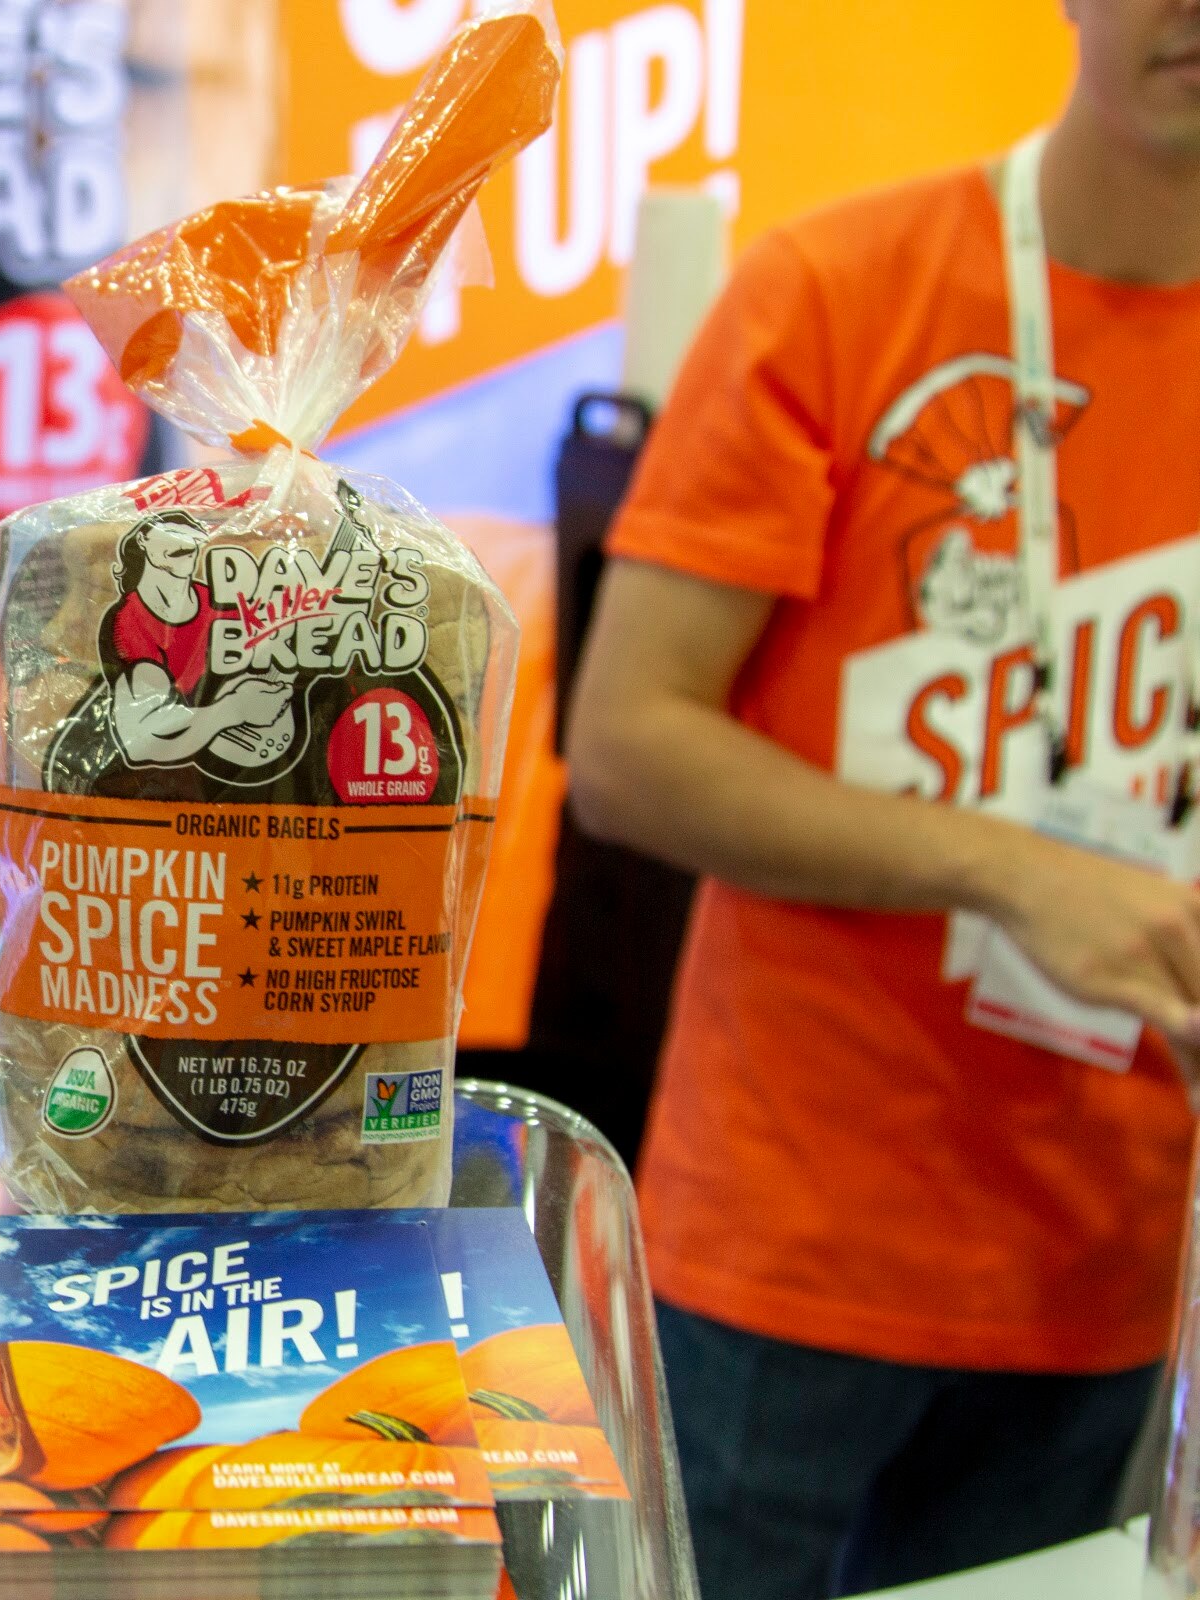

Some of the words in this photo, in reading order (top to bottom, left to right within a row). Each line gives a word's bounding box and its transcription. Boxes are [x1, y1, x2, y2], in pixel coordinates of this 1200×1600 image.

[513, 0, 743, 297] UP!
[207, 546, 431, 607] DAVE'S
[211, 611, 428, 675] BREAD
[347, 781, 383, 797] WHOLE
[386, 781, 426, 797] GRAINS
[175, 813, 260, 838] ORGANIC
[267, 815, 341, 840] BAGELS
[41, 840, 227, 900] PUMPKIN
[271, 873, 303, 900] 11g
[309, 875, 379, 897] PROTEIN
[270, 911, 349, 932] PUMPKIN
[354, 910, 406, 931] SWIRL
[39, 892, 225, 979] SPICE
[269, 937, 282, 958] &
[287, 937, 345, 958] SWEET
[349, 935, 403, 957] MAPLE
[266, 970, 290, 989] NO
[295, 969, 336, 990] HIGH
[339, 968, 420, 989] FRUCTOSE
[39, 965, 220, 1026] MADNESS
[264, 991, 314, 1011] CORN
[319, 992, 376, 1012] SYRUP
[178, 1056, 209, 1074] NET
[212, 1056, 237, 1075] WT
[240, 1057, 282, 1076] 16.75
[287, 1060, 306, 1078] OZ
[191, 1077, 206, 1097] (1
[209, 1078, 228, 1095] LB
[231, 1078, 263, 1096] 0.75
[266, 1079, 290, 1098] OZ)
[411, 1073, 441, 1089] NON
[410, 1086, 441, 1101] GMO
[219, 1098, 257, 1117] 475g
[368, 1114, 439, 1130] VERIFIED
[47, 1241, 250, 1312] SPICE
[140, 1295, 172, 1320] IS
[181, 1290, 215, 1314] IN
[222, 1276, 282, 1305] THE
[154, 1289, 359, 1377] AIR!
[212, 1463, 266, 1476] LEARN
[270, 1463, 320, 1475] MORE
[323, 1462, 341, 1474] AT
[212, 1471, 456, 1489] DAVESKILLERBREAD.COM
